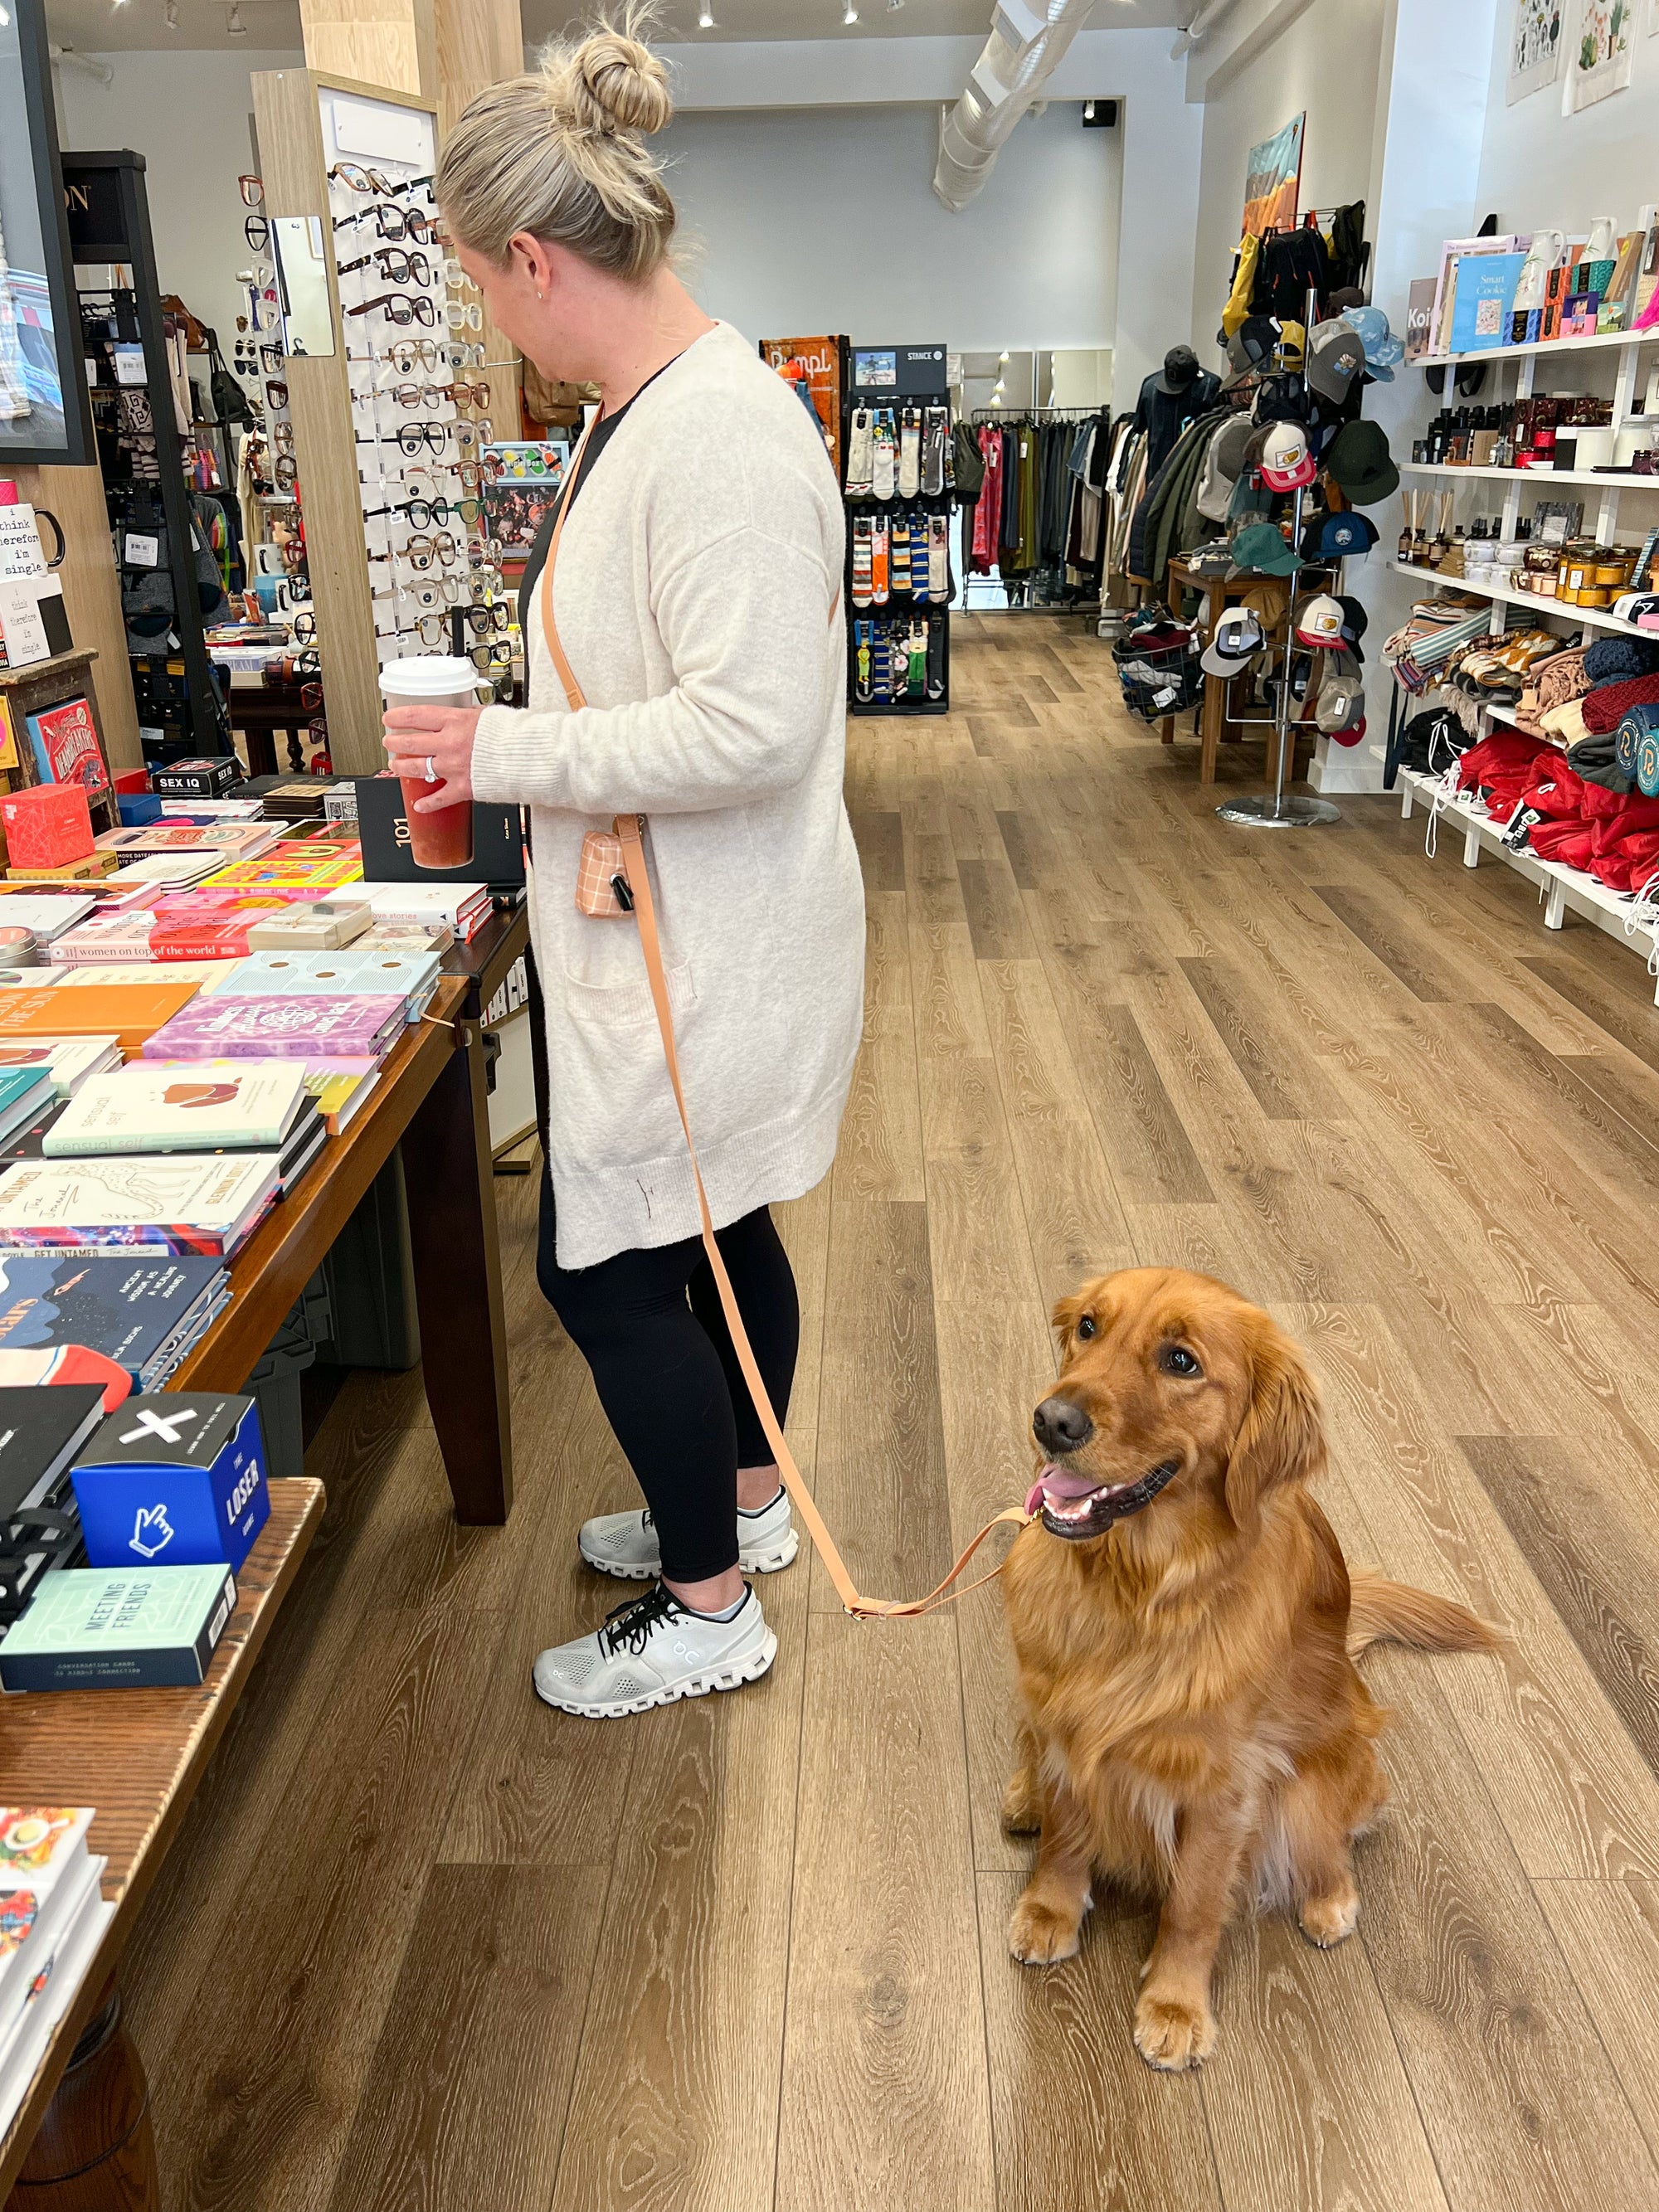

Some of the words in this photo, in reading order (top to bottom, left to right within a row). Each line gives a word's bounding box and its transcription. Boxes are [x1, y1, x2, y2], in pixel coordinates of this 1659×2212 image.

[1477, 285, 1506, 294] Cookie
[1481, 275, 1505, 284] Smart
[771, 348, 832, 378] Rmpl
[907, 352, 932, 360] STANCE
[0, 519, 31, 530] think
[160, 778, 184, 788] SEX
[187, 778, 200, 788] IQ
[217, 769, 227, 780] SEX
[226, 766, 232, 775] IQ
[393, 818, 411, 848] 101
[95, 912, 146, 939] women
[127, 927, 151, 939] on
[141, 915, 177, 928] top
[169, 916, 200, 928] the
[190, 916, 231, 939] world
[159, 927, 182, 939] of
[80, 947, 117, 955] women
[134, 947, 152, 958] top
[153, 946, 165, 955] of
[166, 946, 183, 955] the
[184, 945, 216, 955] world
[0, 1010, 36, 1027] THE
[21, 991, 60, 1009] SUN
[194, 1005, 246, 1032] Kindness
[318, 1002, 353, 1016] back
[229, 1005, 269, 1034] Always
[310, 1016, 340, 1033] comes
[81, 1096, 112, 1127] sensual
[106, 1111, 126, 1125] self
[55, 1138, 112, 1153] sensual
[118, 1136, 144, 1150] self
[2, 1171, 41, 1204] UNTAMED
[23, 1197, 44, 1213] The
[55, 1248, 99, 1257] UNTAMED
[119, 1268, 144, 1294] ANCIENT
[127, 1281, 151, 1302] WISDOM
[147, 1270, 159, 1281] AS
[154, 1266, 178, 1290] HEALING
[161, 1274, 187, 1299] JOURNEY
[111, 1345, 125, 1360] ULIA
[233, 1451, 244, 1471] THE
[226, 1458, 260, 1526] LOSER
[84, 1582, 126, 1631] MEETING
[112, 1582, 152, 1628] FRIENDS
[57, 1661, 109, 1670] CONVERSATION
